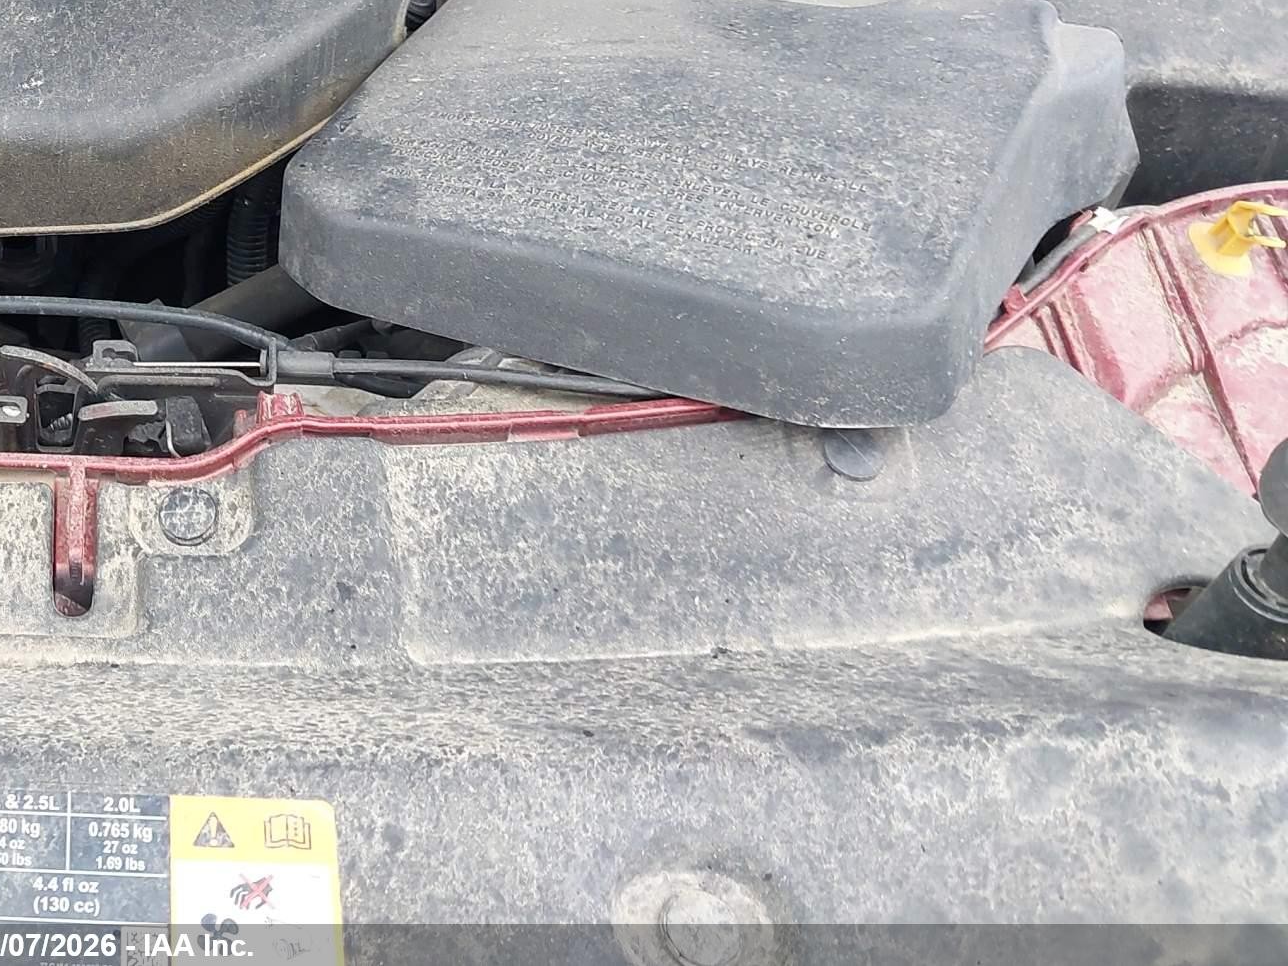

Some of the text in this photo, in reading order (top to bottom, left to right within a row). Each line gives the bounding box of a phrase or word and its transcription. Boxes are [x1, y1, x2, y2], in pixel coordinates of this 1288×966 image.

[751, 194, 770, 207] LE
[780, 202, 871, 233] COUVERCLE
[5, 794, 19, 810] &
[23, 795, 60, 811] 2.5L
[103, 797, 141, 813] 2.0L
[21, 818, 41, 837] kg
[88, 822, 153, 842] 0.765 kg
[9, 838, 26, 850] oz
[103, 841, 138, 854] 27 oz
[12, 853, 32, 866] lbs
[96, 856, 145, 871] 1.69 lbs
[32, 876, 99, 893] 4.4 fl oz
[33, 896, 100, 916] (130 cc)
